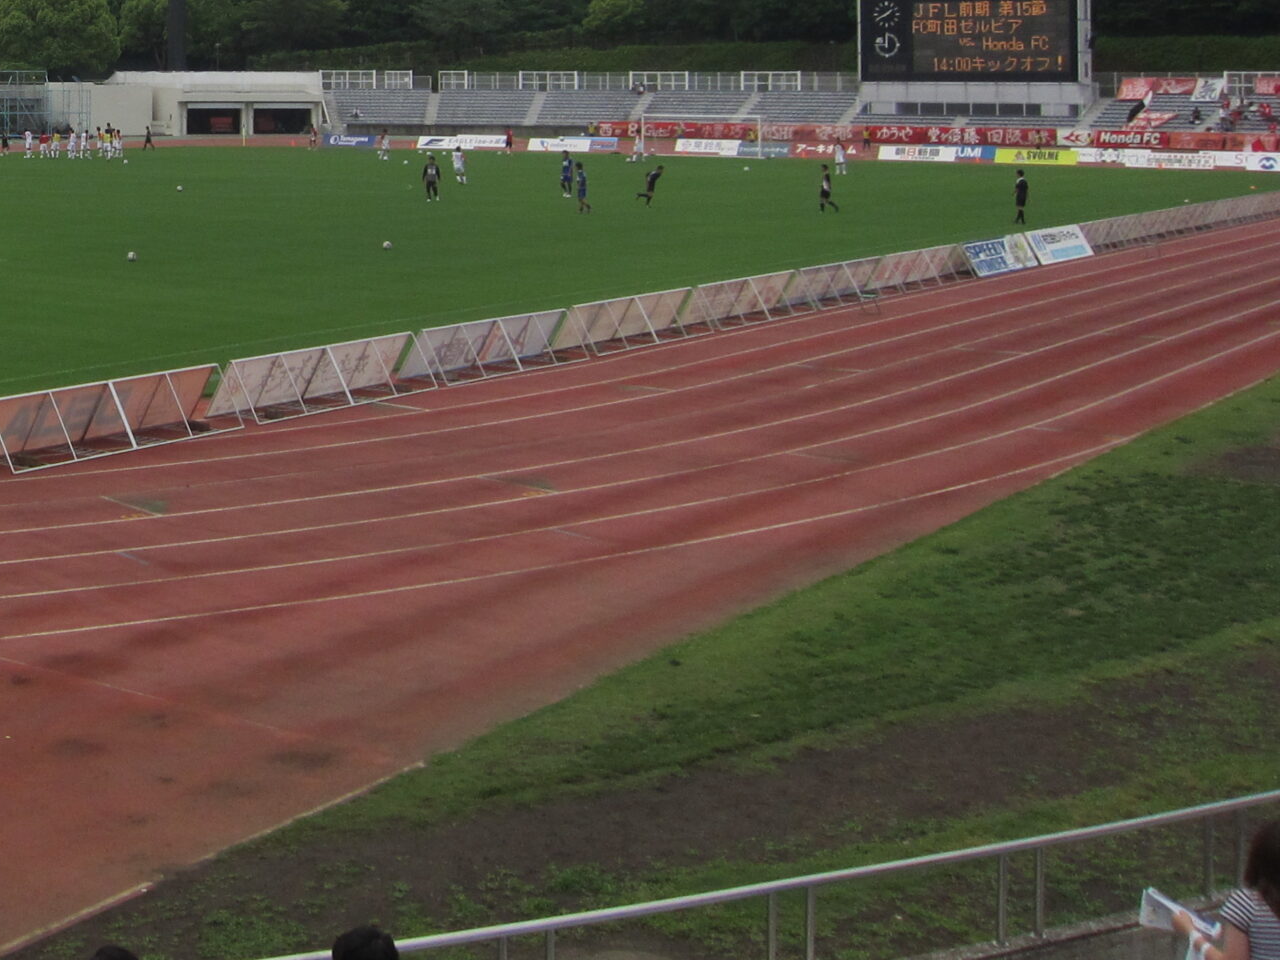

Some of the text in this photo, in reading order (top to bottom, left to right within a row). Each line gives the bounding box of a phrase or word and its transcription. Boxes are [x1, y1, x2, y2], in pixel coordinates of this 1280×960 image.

[998, 0, 1047, 17] 第15節
[912, 19, 1023, 35] FC町田ゼルビア
[983, 38, 1024, 52] Honda
[1031, 36, 1049, 50] FC
[1100, 132, 1161, 145] Honda FC
